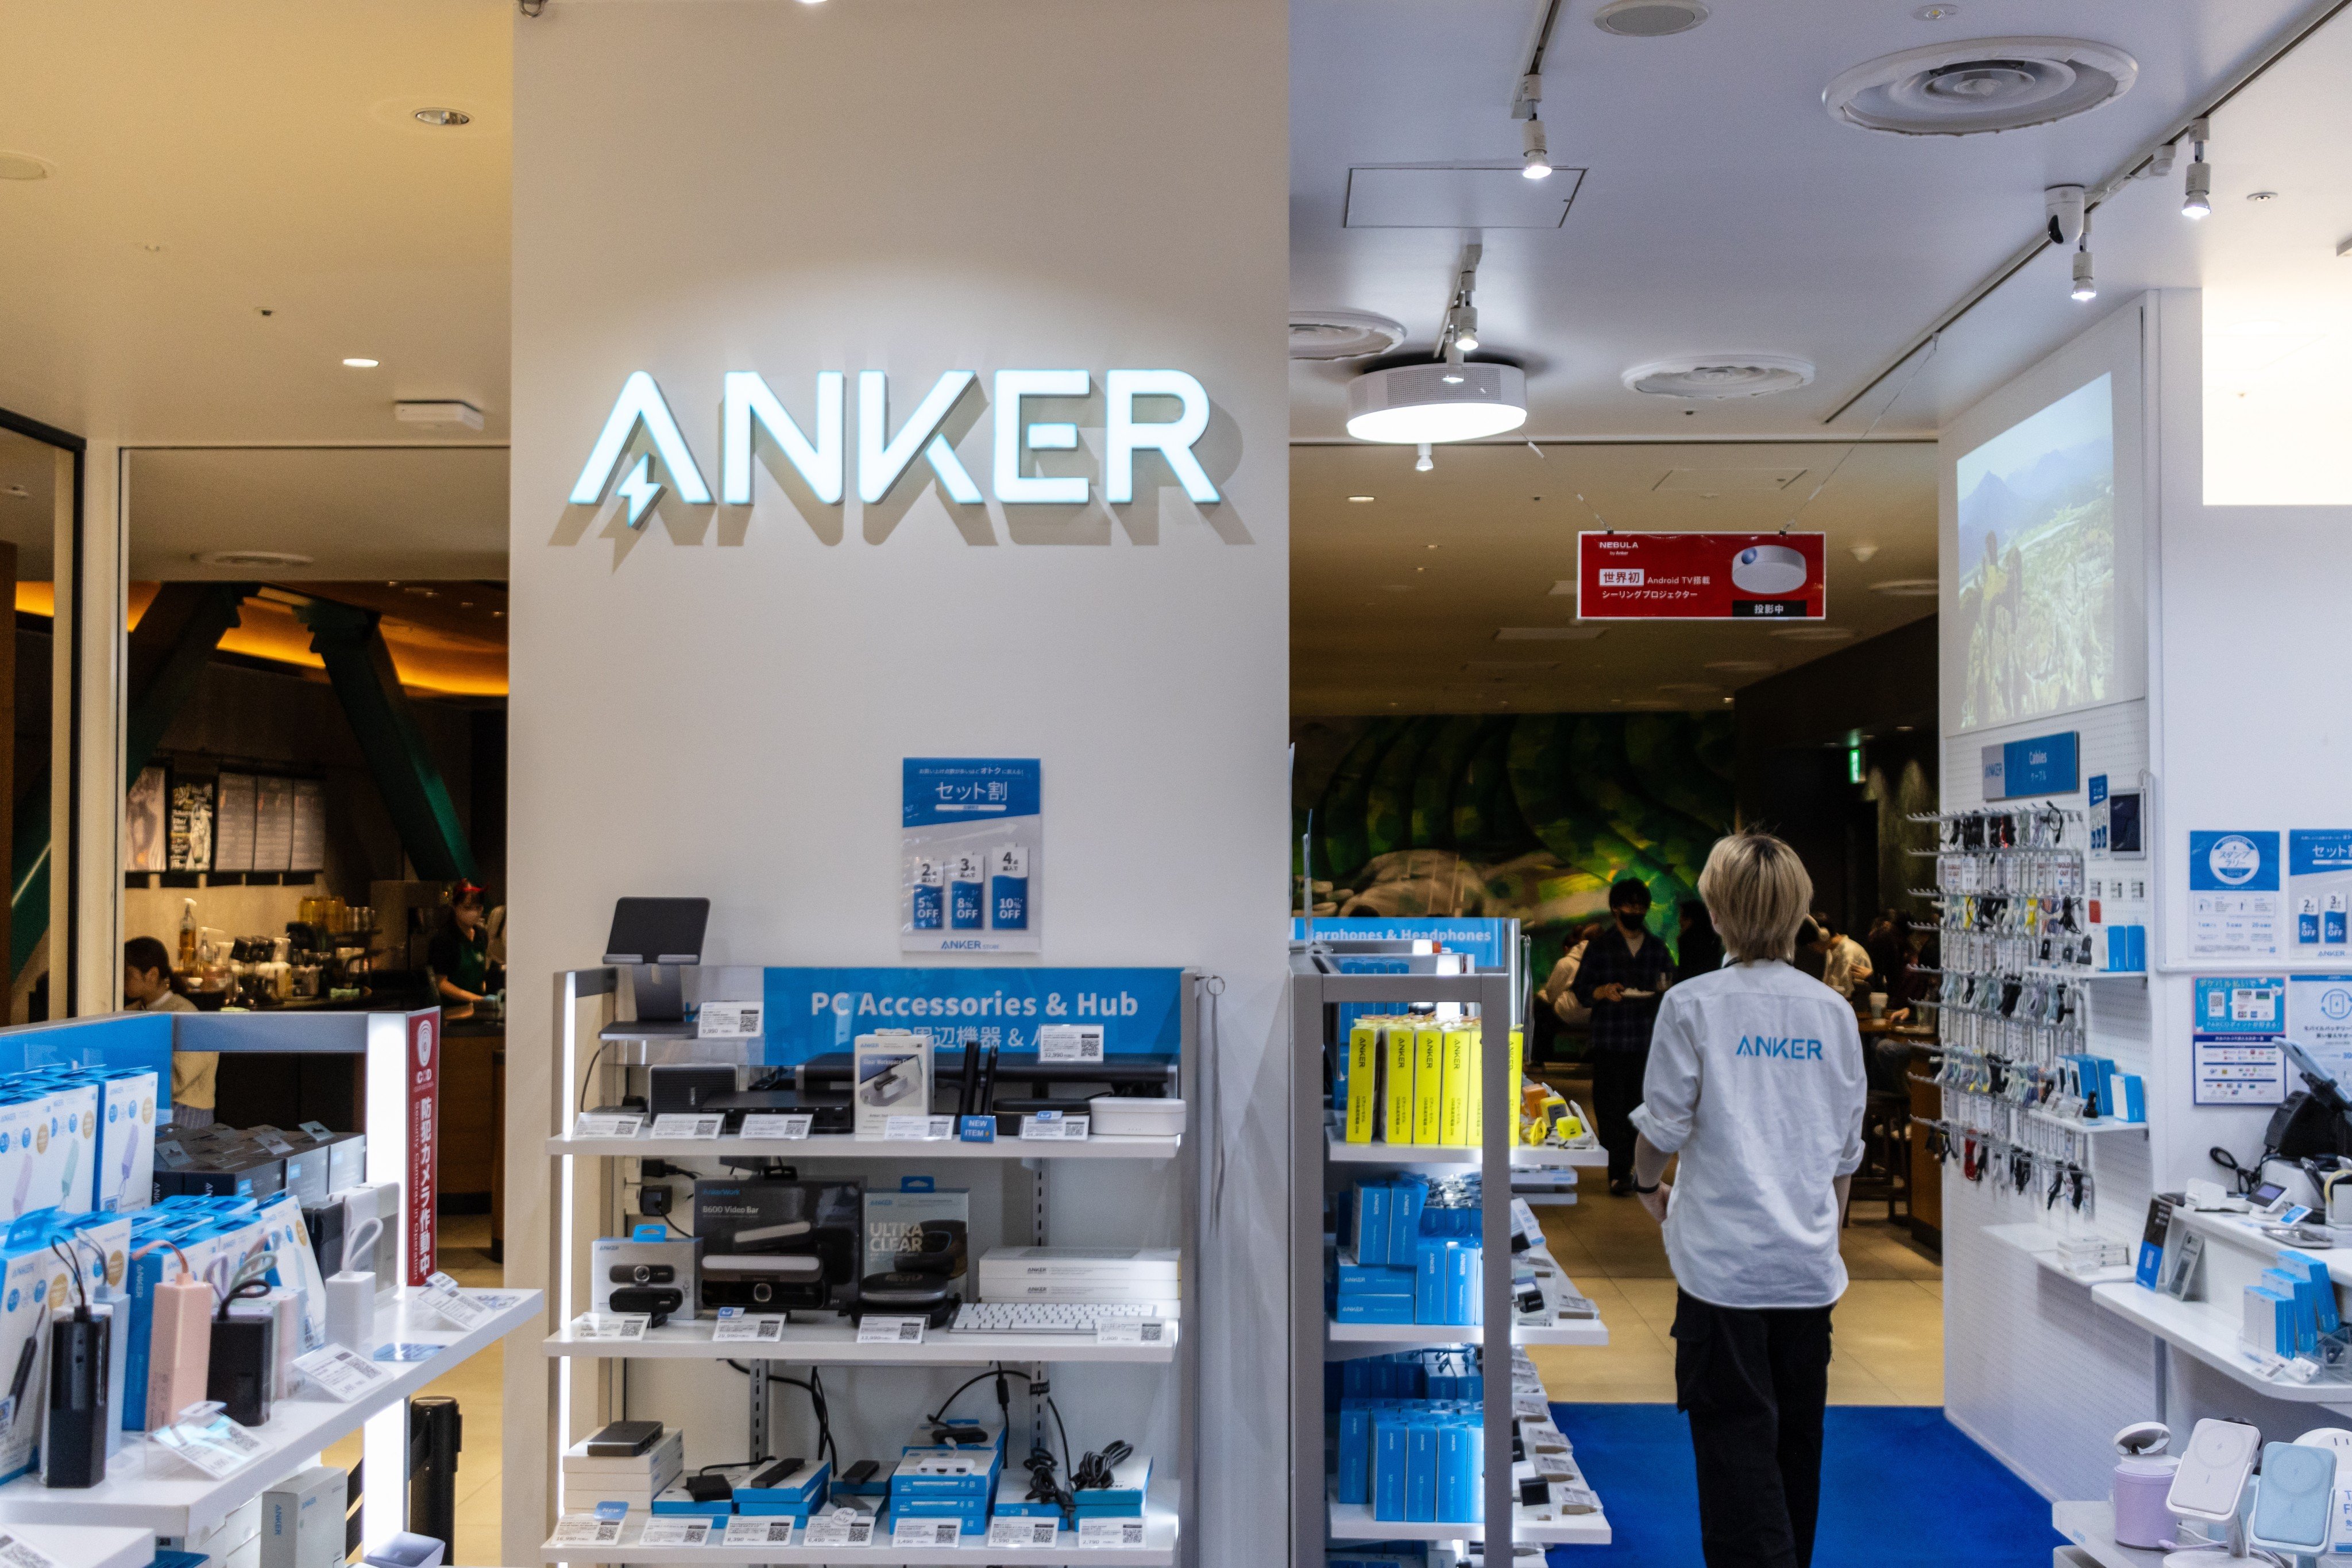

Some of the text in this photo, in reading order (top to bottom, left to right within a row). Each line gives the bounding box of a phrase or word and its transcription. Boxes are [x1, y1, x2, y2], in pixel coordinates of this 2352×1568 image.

[568, 370, 1221, 526] ANKER
[1604, 571, 1640, 584] 世界初
[1682, 576, 1710, 585] TV搭載
[1602, 590, 1698, 599] シーリングプロジェクター
[1754, 604, 1784, 614] 投影中
[935, 781, 1007, 801] セット割
[2312, 845, 2352, 858] セット
[918, 897, 933, 908] 5%
[957, 897, 973, 908] 8%
[999, 898, 1021, 909] 10%
[917, 909, 939, 918] OFF
[957, 909, 978, 918] OFF
[999, 910, 1021, 919] OFF
[1312, 929, 1382, 939] arphones
[1401, 929, 1492, 942] Headphones
[941, 940, 981, 949] ANKER
[812, 991, 1138, 1016] PC Accessories & Hub
[1008, 1028, 1024, 1047] &
[1736, 1034, 1823, 1060] ANKER
[153, 1182, 161, 1204] ANK
[420, 1097, 432, 1276] 防犯カメラ作動中
[870, 1222, 924, 1237] ULTRA
[870, 1237, 923, 1252] CLEAR
[136, 1264, 144, 1298] ANKER
